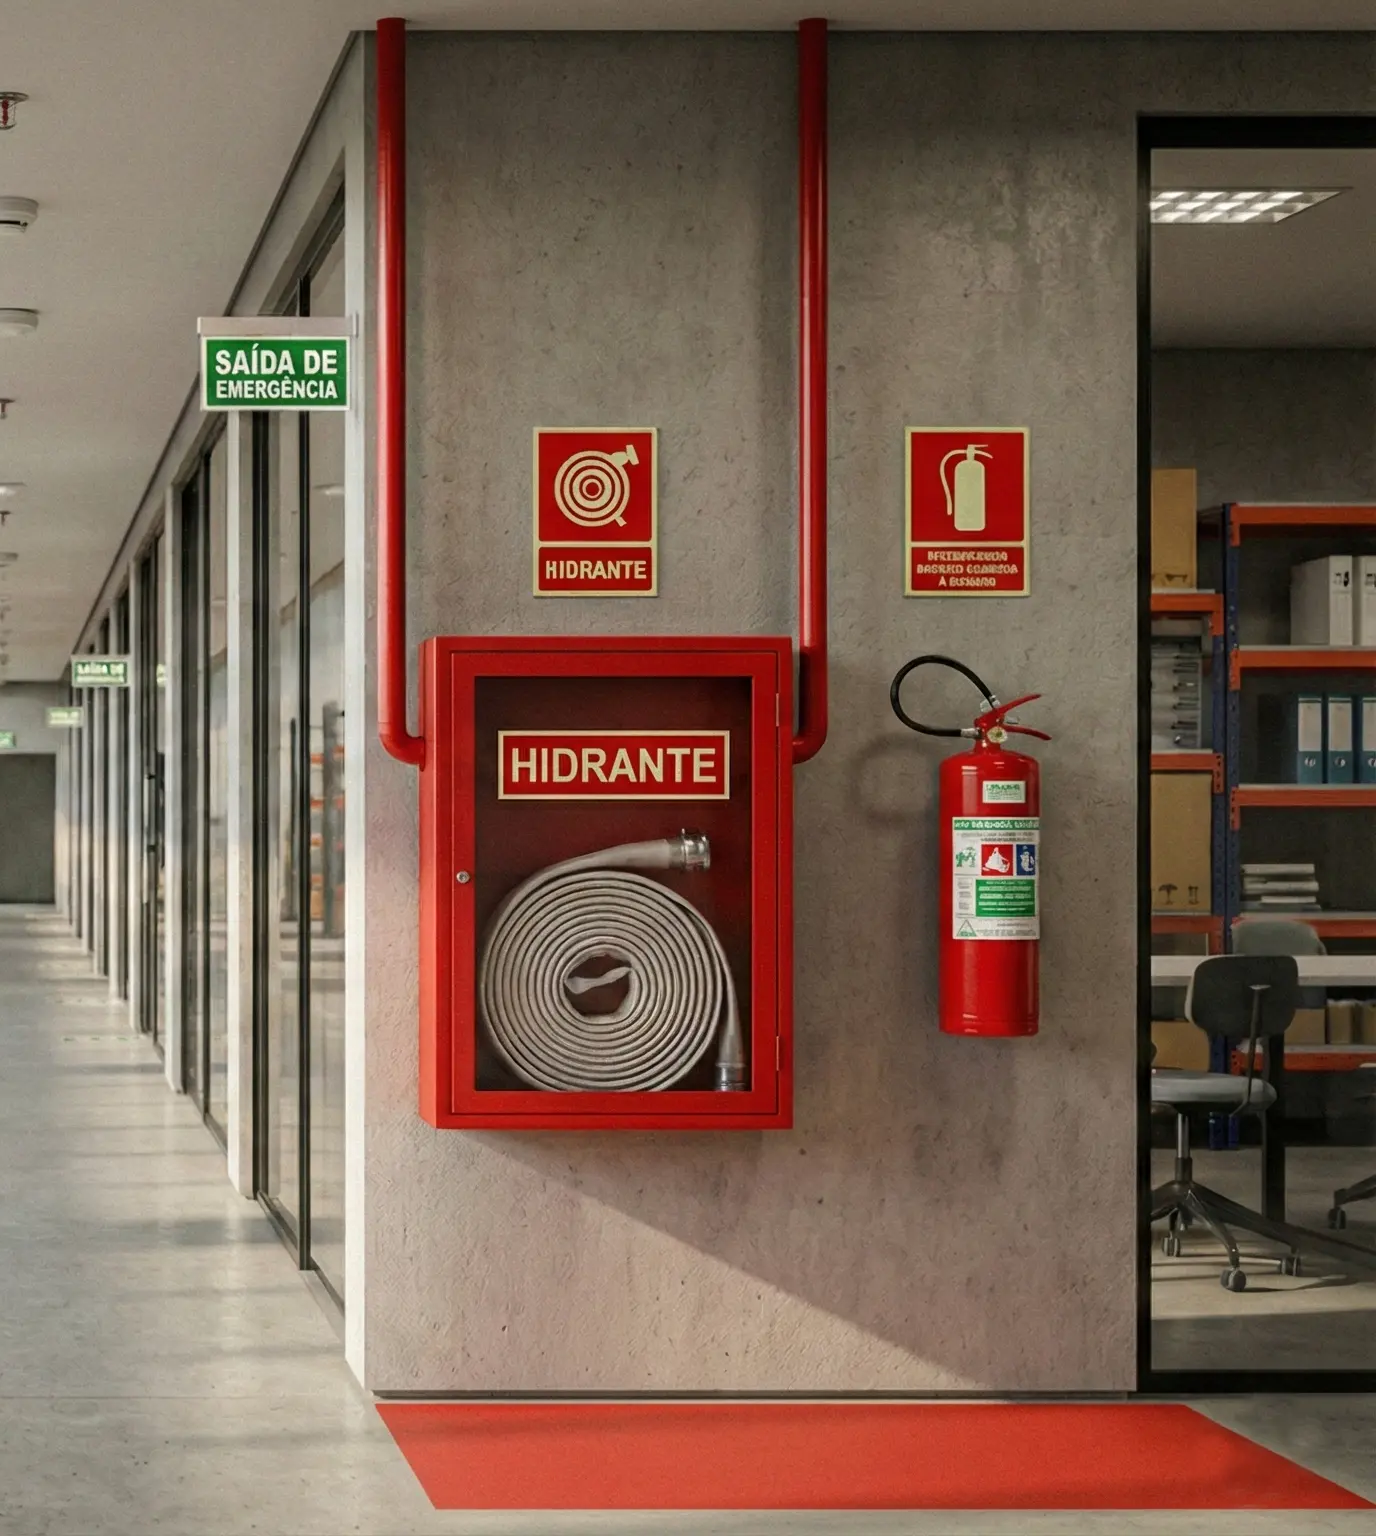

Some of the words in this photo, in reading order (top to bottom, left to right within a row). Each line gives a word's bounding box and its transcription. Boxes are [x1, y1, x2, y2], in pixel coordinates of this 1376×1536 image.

[216, 343, 295, 375] SAÍDA
[304, 350, 338, 375] DE
[216, 376, 338, 399] EMERGÊNCIA
[545, 560, 647, 579] HIDRANTE
[511, 748, 717, 783] HIDRANTE
